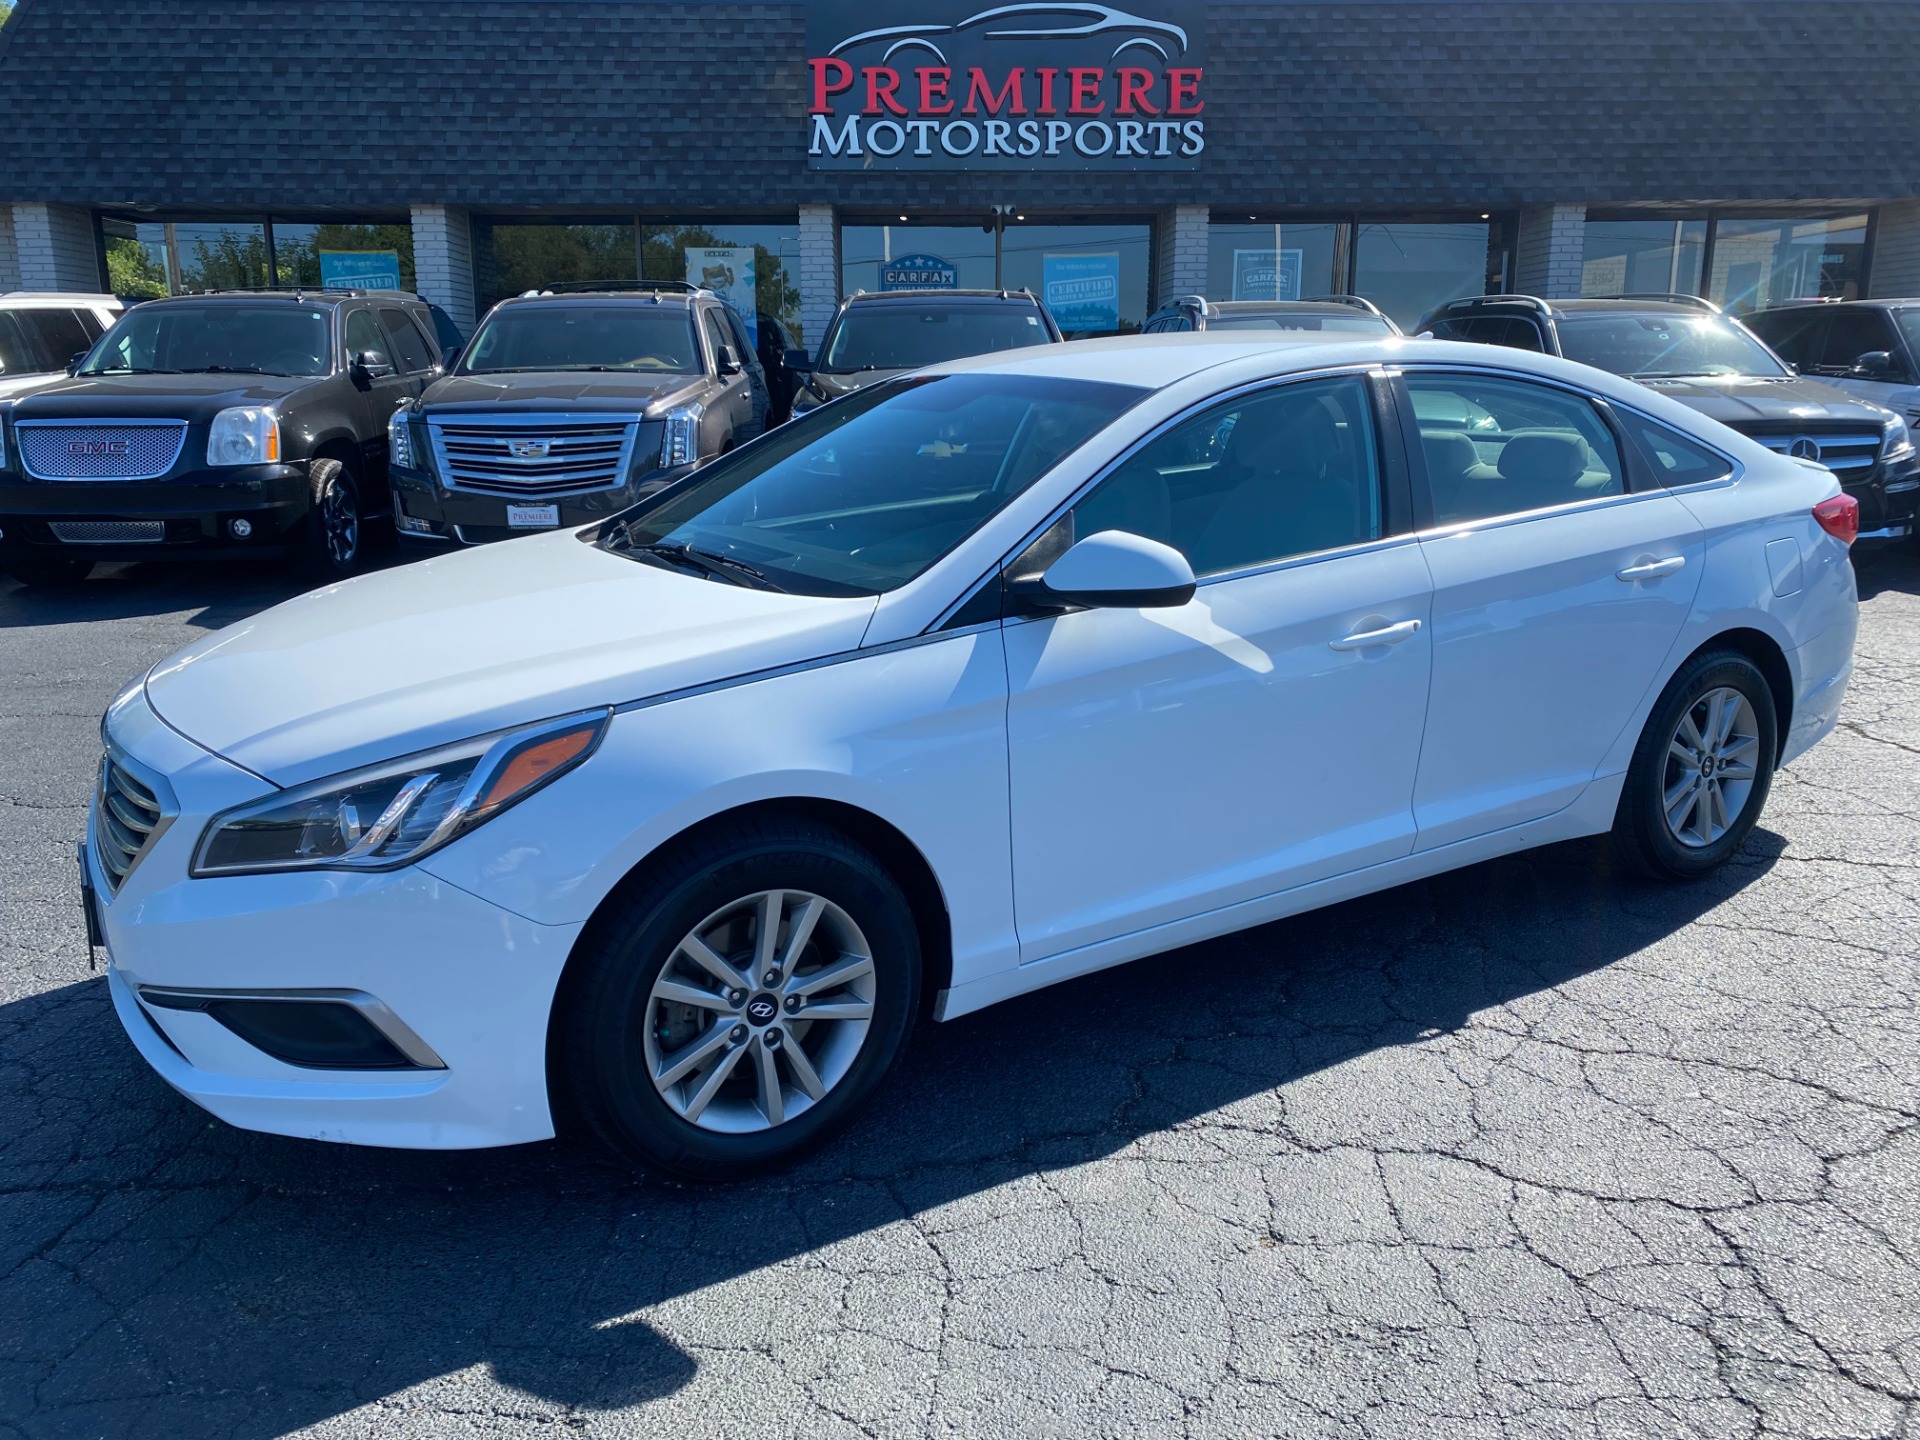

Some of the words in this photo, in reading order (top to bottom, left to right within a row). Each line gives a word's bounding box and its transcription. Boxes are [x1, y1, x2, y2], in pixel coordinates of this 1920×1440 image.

[807, 57, 1205, 116] PREMIERE
[807, 114, 1205, 157] MOTORSPORTS
[886, 271, 952, 284] CARFAX
[1050, 279, 1113, 296] CERTIFIED
[67, 440, 129, 455] GMC
